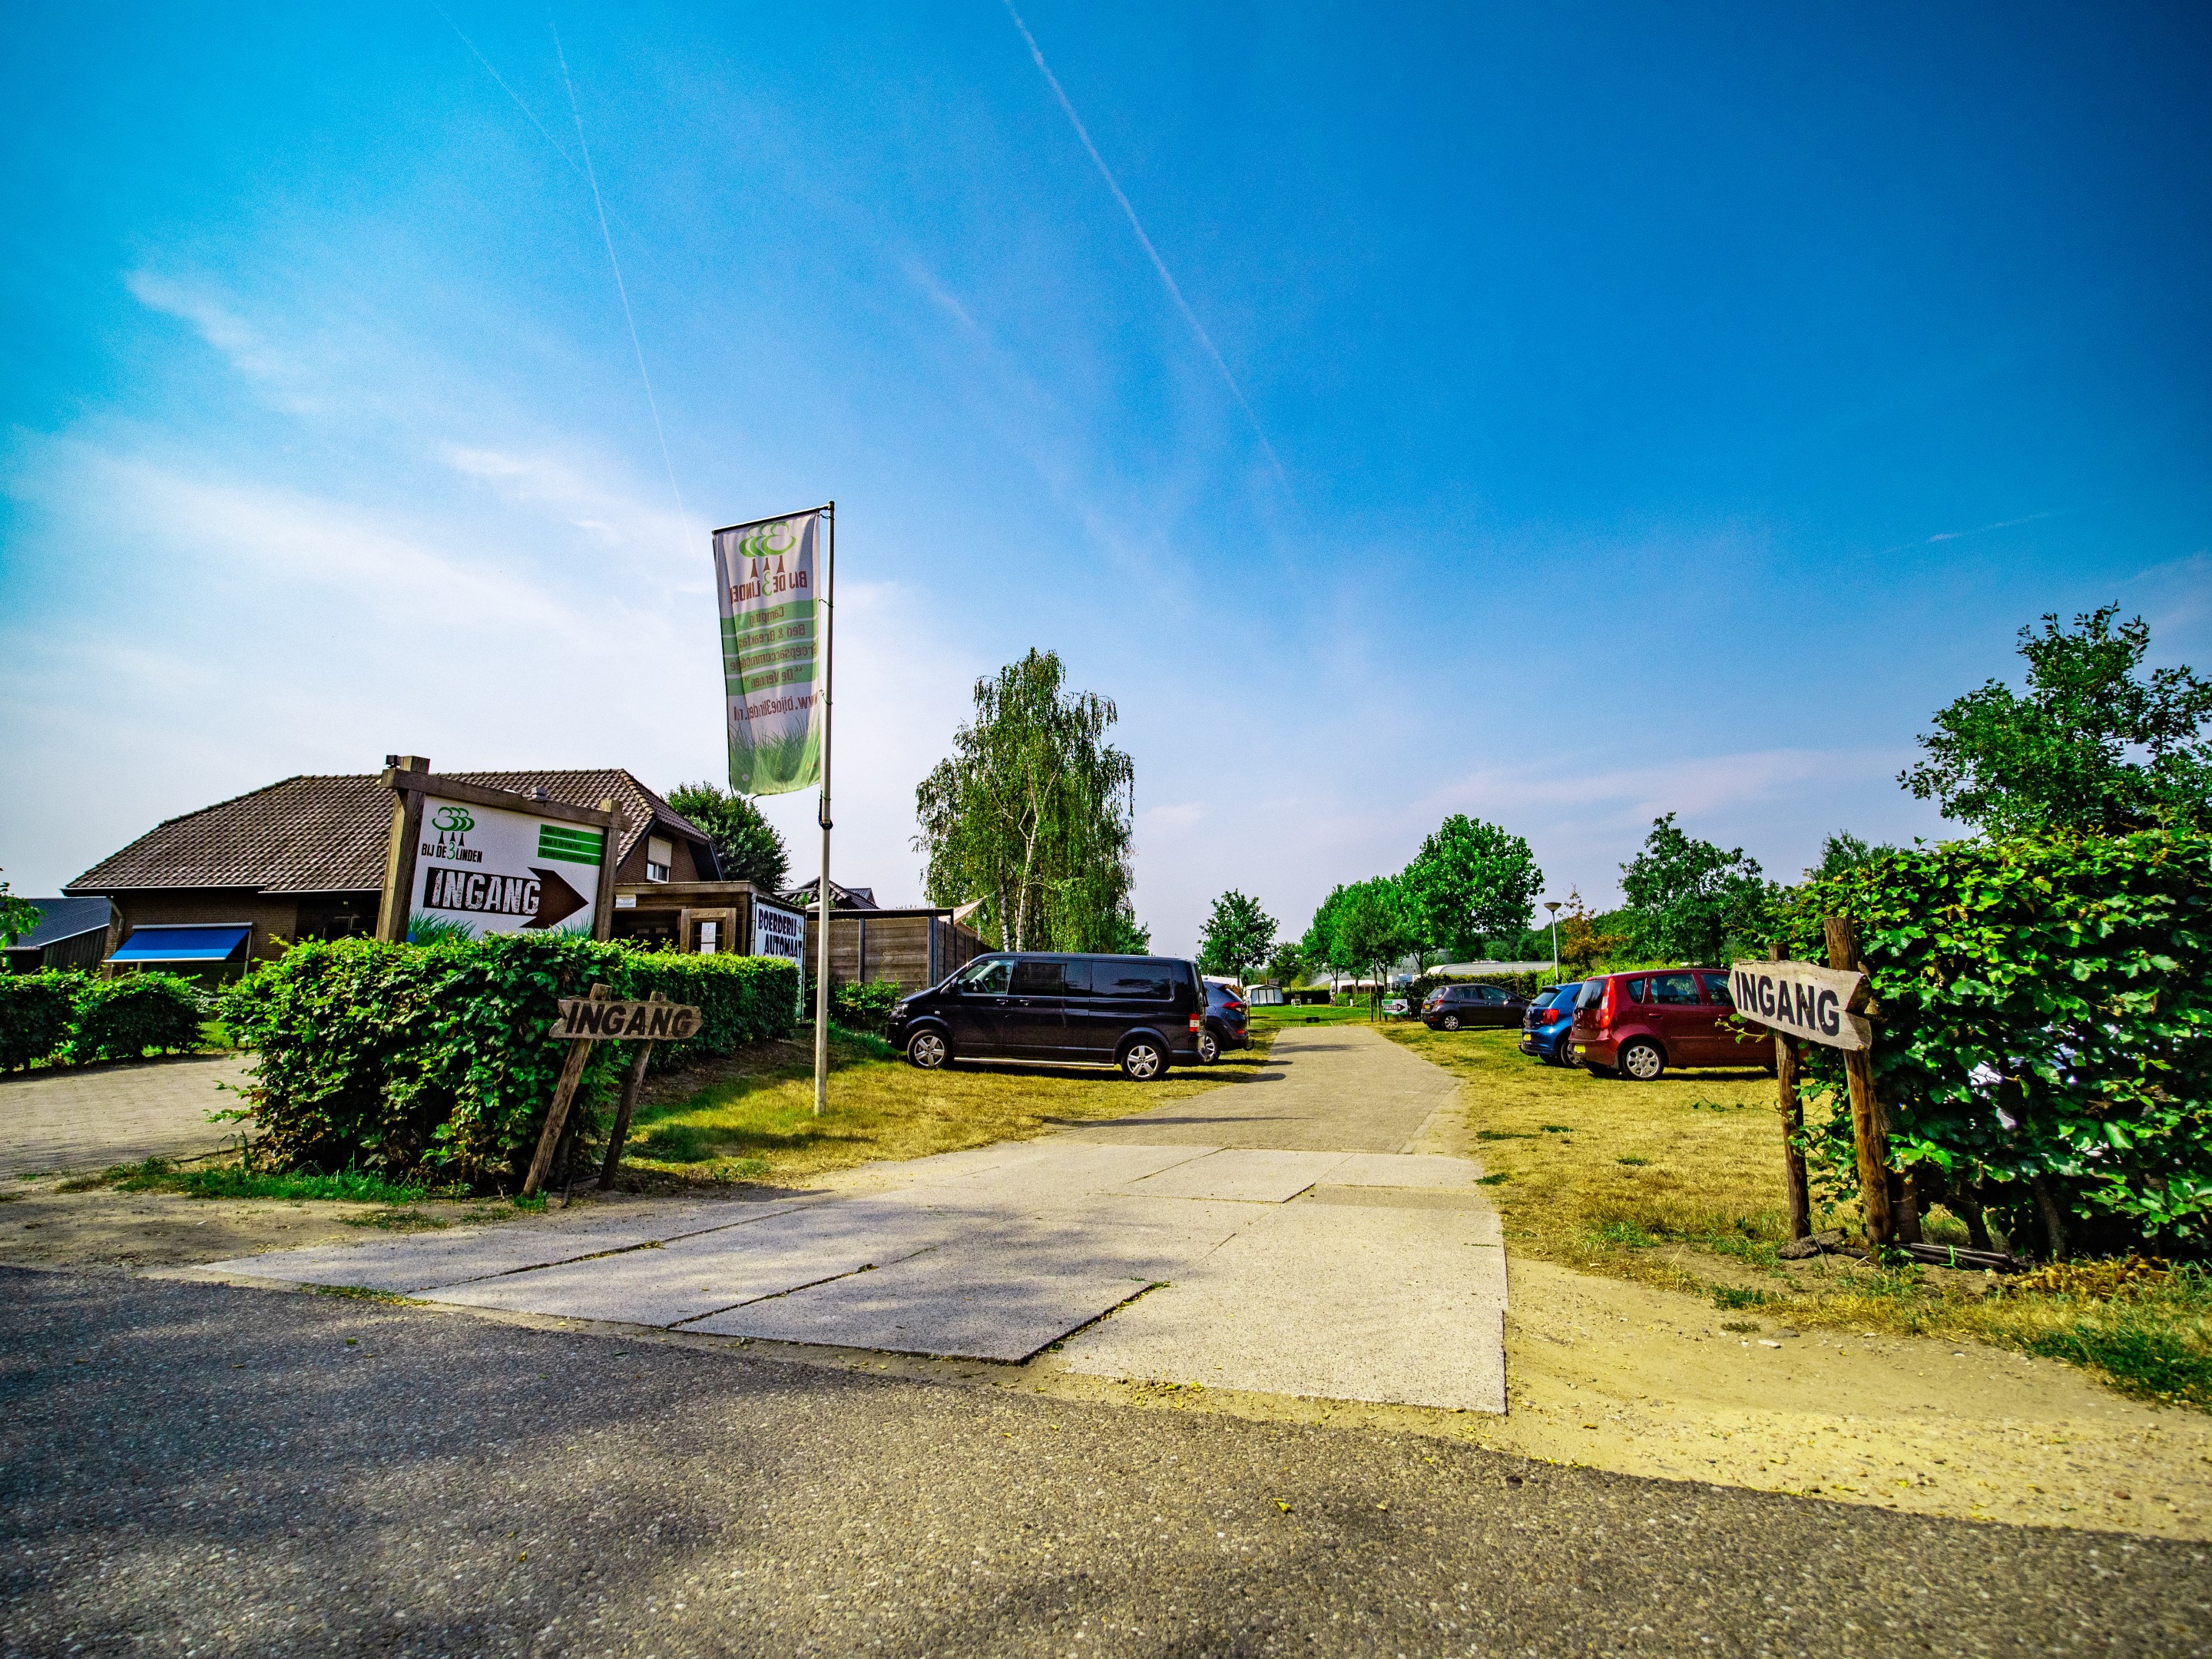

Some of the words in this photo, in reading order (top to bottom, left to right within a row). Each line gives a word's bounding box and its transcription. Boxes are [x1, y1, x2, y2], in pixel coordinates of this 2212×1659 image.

[422, 843, 435, 856] BIJ
[436, 845, 447, 858] DE
[447, 841, 455, 859] 3
[455, 847, 482, 863] LINDEN
[431, 869, 541, 915] INGANG
[758, 908, 797, 937] BOERDERIJ
[764, 933, 803, 959] AUTOMAAT
[565, 1002, 693, 1037] INGANG
[1734, 970, 1839, 1037] INGANG
